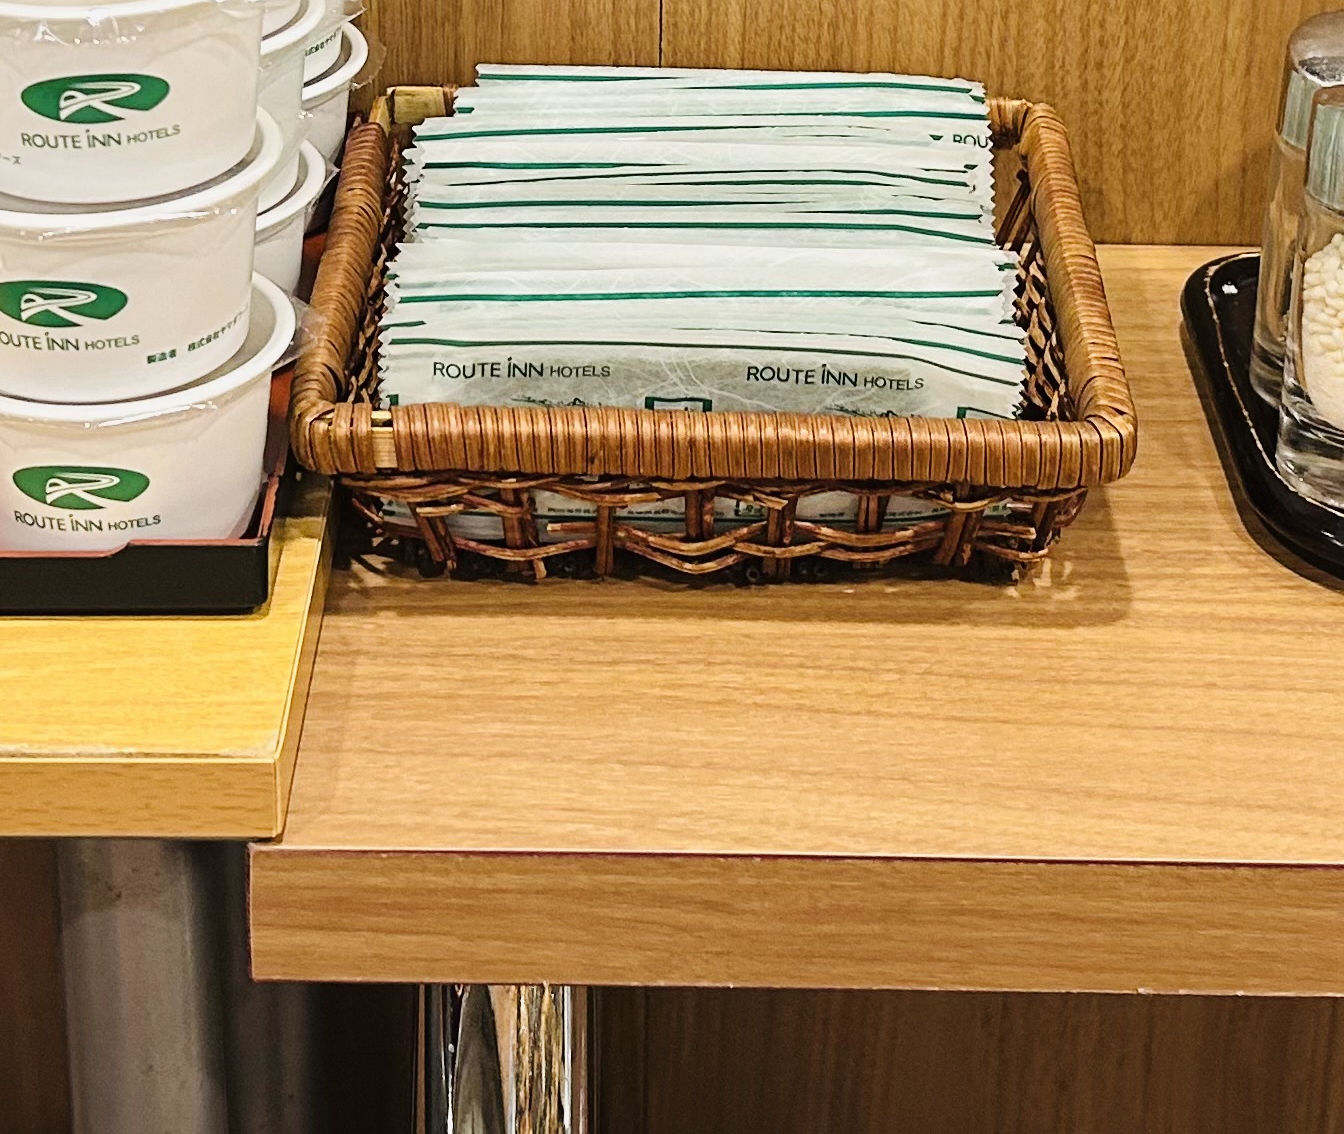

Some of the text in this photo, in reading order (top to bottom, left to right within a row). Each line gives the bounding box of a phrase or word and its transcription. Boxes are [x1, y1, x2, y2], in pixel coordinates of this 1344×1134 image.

[20, 132, 83, 149] ROUTE
[127, 124, 181, 145] HOTELS
[84, 334, 141, 351] HOTELS
[433, 361, 502, 379] ROUTE
[550, 365, 611, 378] HOTELS
[746, 365, 816, 385] ROUTE
[863, 376, 925, 391] HOTELS
[13, 510, 67, 532] ROUTE
[108, 514, 162, 531] HOTELS
